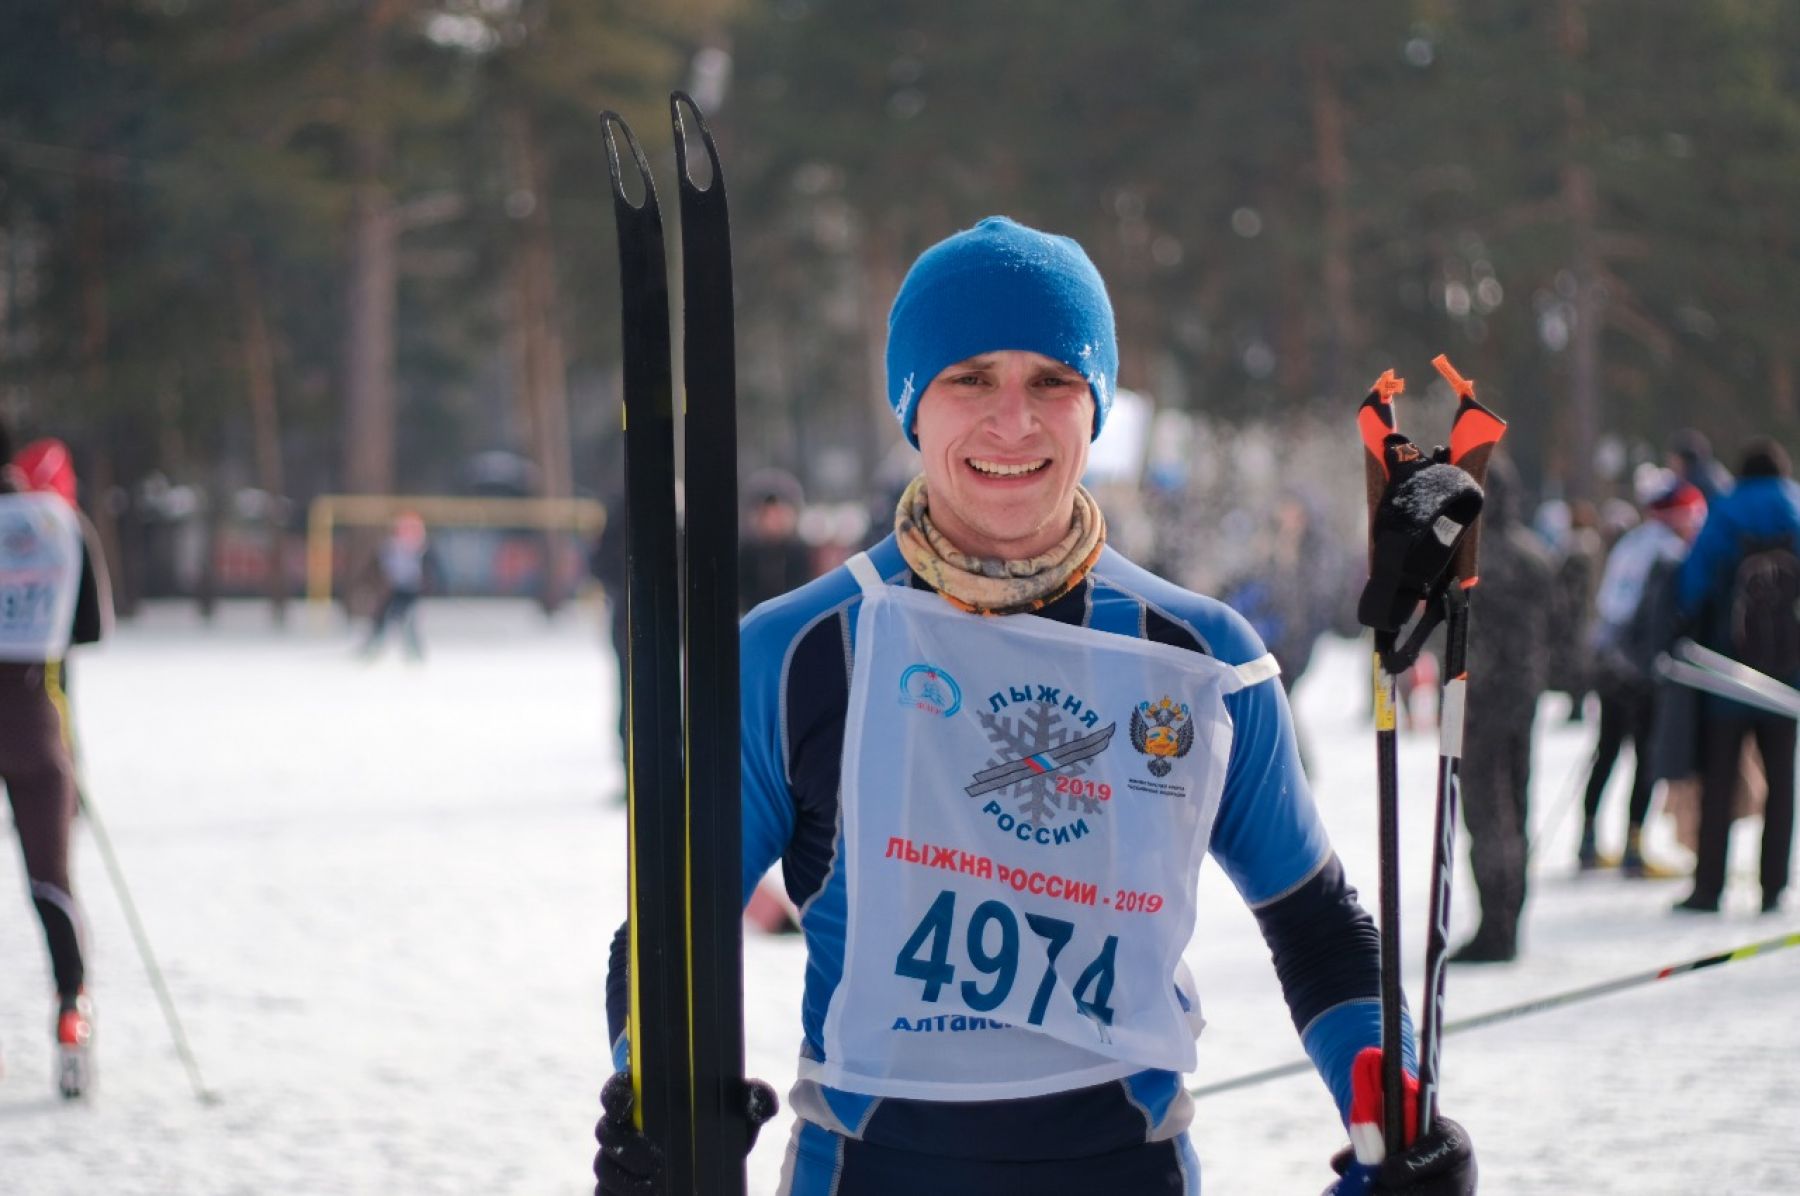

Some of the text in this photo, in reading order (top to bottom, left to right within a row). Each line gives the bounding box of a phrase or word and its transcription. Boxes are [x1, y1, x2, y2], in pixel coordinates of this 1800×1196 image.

[988, 684, 1099, 729] ЛЫЖНЯ
[1056, 776, 1112, 801] 2019
[983, 800, 1090, 845] РОССИИ
[885, 836, 993, 880] ЛЫЖНЯ
[996, 863, 1098, 906] РОССИИ
[1114, 889, 1164, 913] 2019
[894, 889, 1119, 1027] 4974
